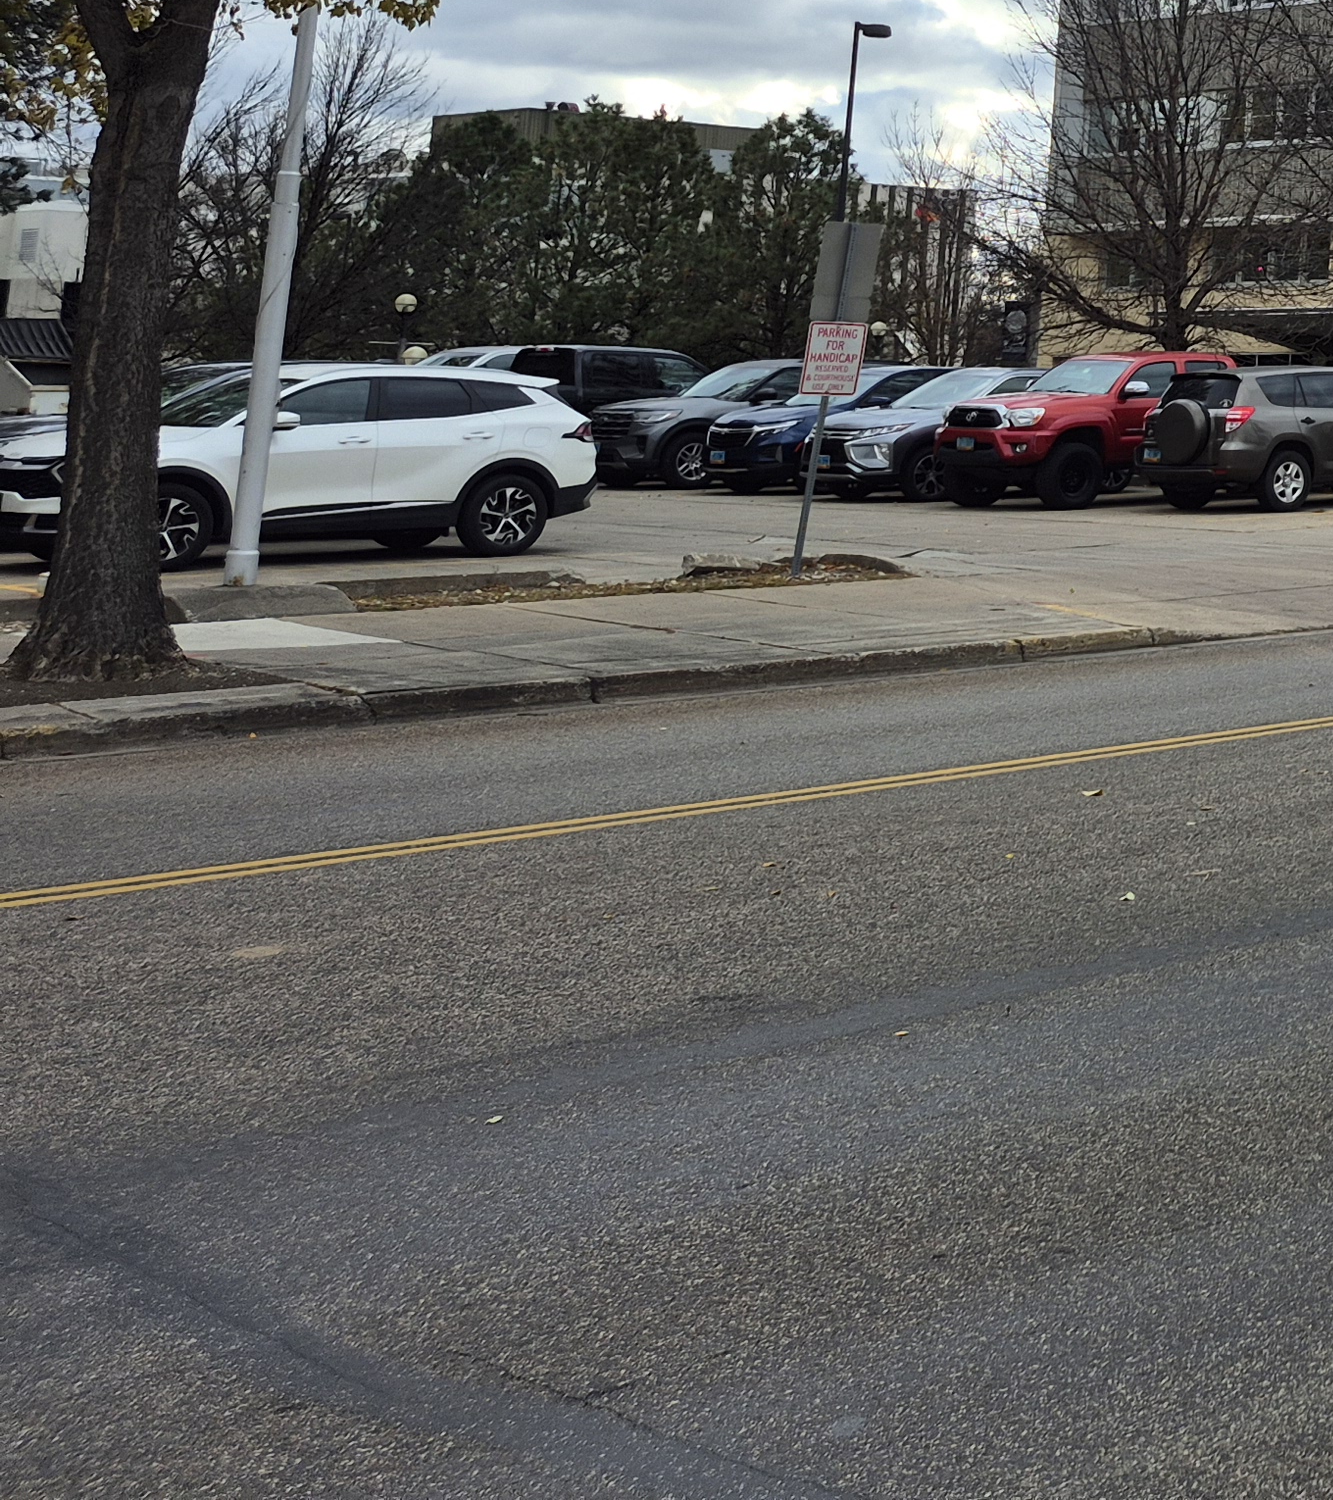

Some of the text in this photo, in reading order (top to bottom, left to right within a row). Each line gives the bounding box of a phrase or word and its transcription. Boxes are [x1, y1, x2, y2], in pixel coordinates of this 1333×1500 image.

[817, 327, 858, 339] PARKING
[826, 340, 845, 351] FOR
[809, 352, 858, 363] HANDICAP
